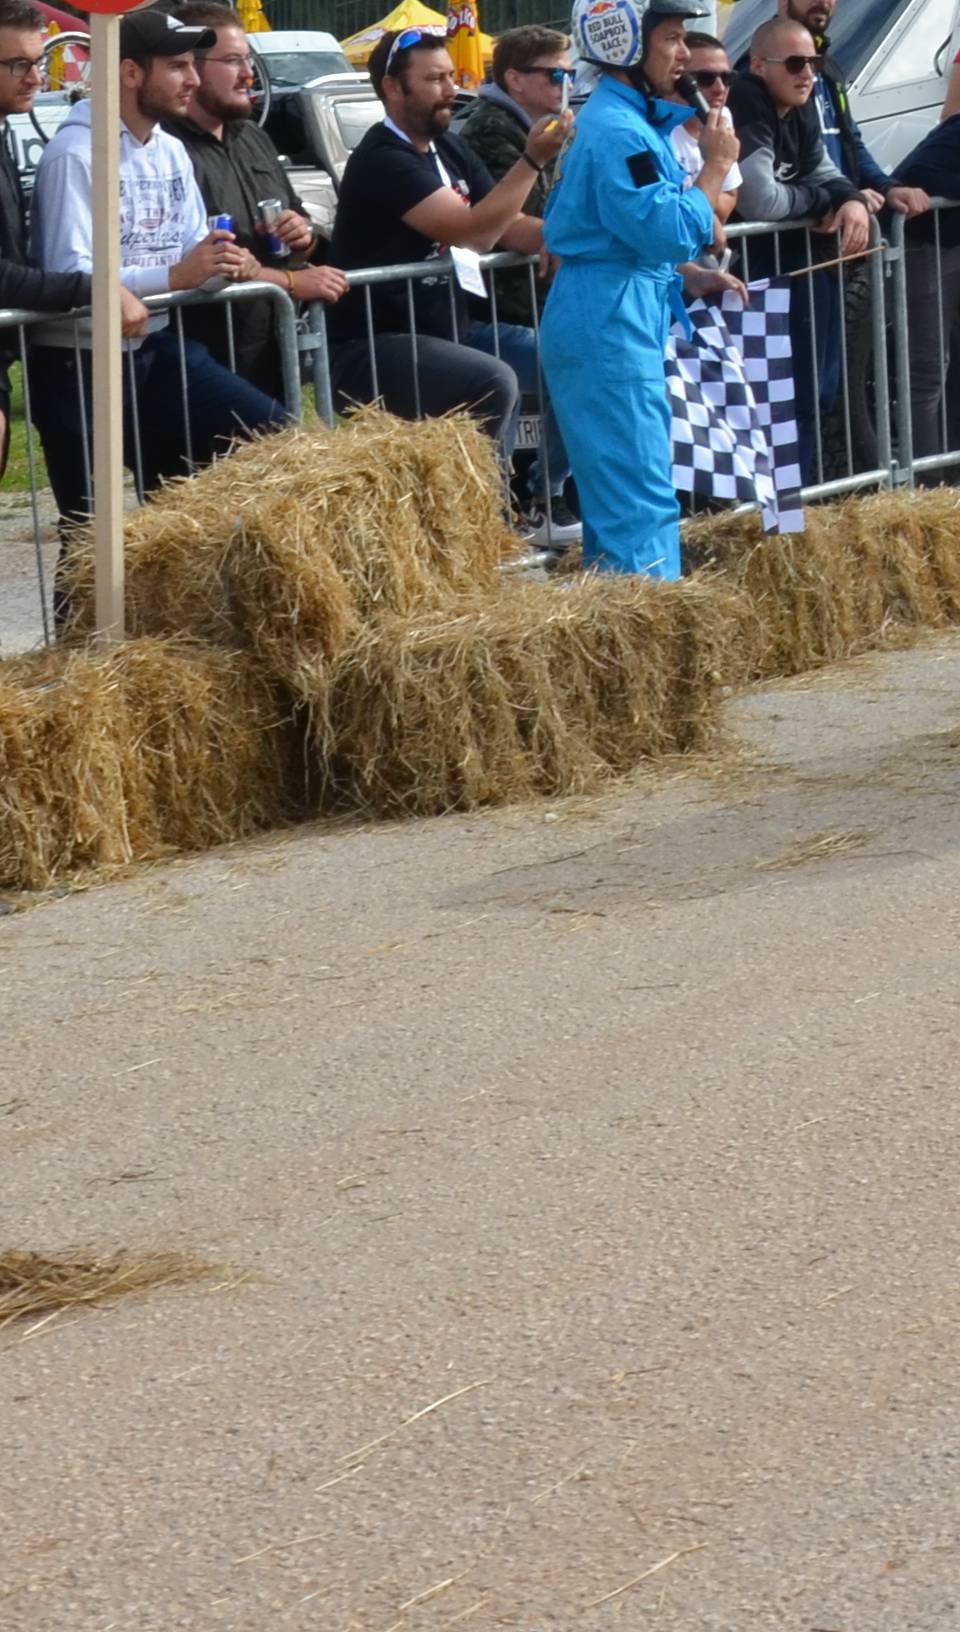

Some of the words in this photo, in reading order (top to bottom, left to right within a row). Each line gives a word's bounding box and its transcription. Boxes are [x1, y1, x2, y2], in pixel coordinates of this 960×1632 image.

[588, 21, 601, 32] RED
[603, 14, 623, 27] BULL
[591, 25, 627, 44] SOAPBOX
[601, 37, 621, 51] RACE
